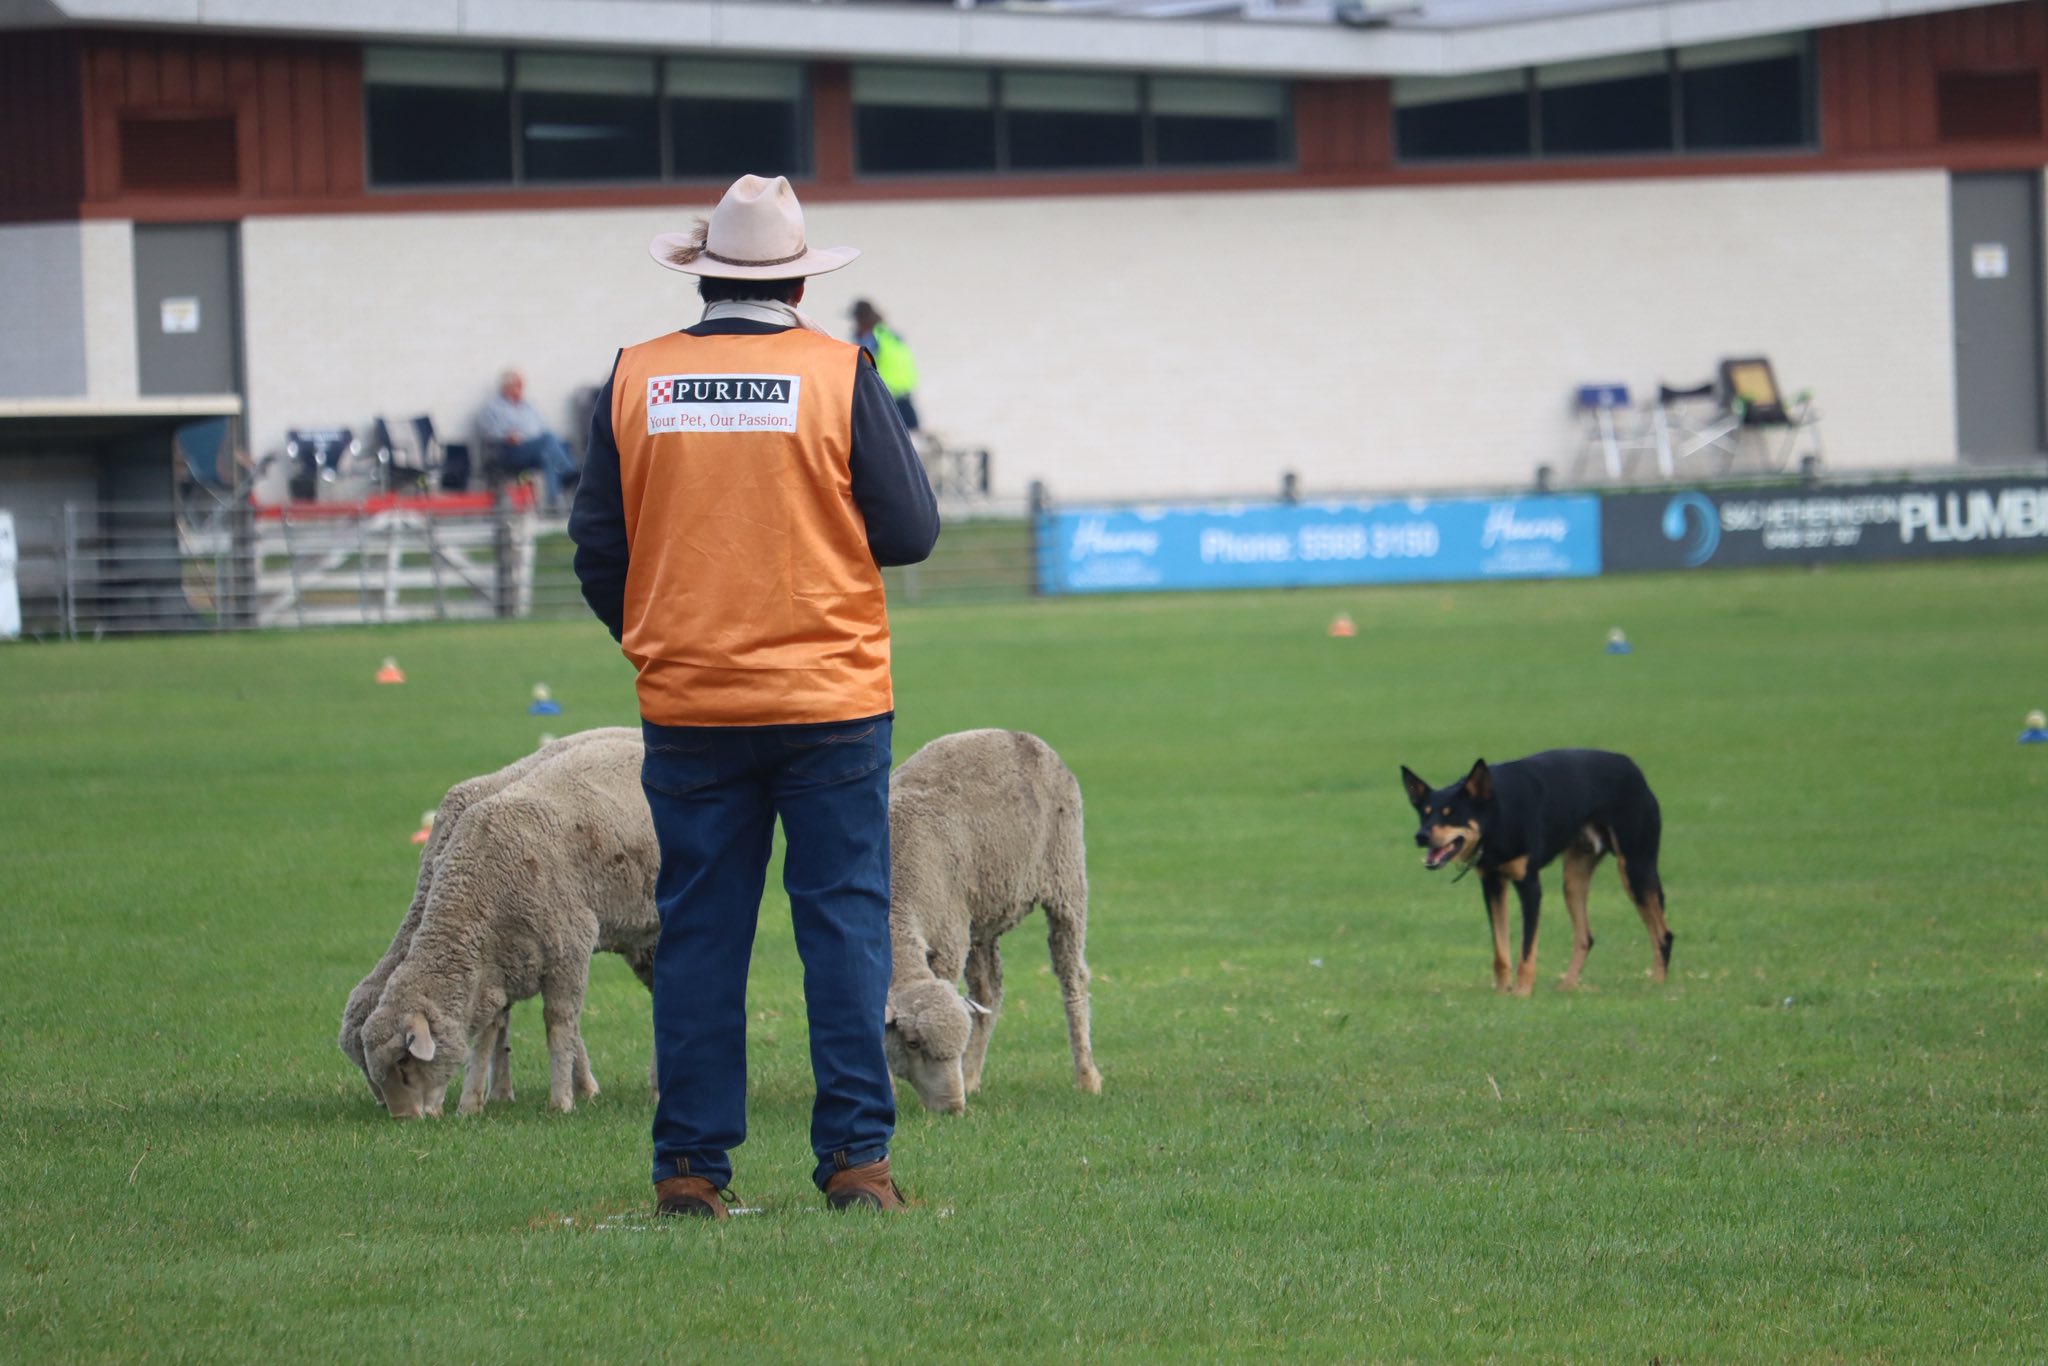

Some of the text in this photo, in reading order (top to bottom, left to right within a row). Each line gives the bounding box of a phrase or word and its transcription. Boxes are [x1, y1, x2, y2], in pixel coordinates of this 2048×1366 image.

[676, 381, 785, 401] PURINA
[650, 412, 792, 429] Your Pet, Our Passion.
